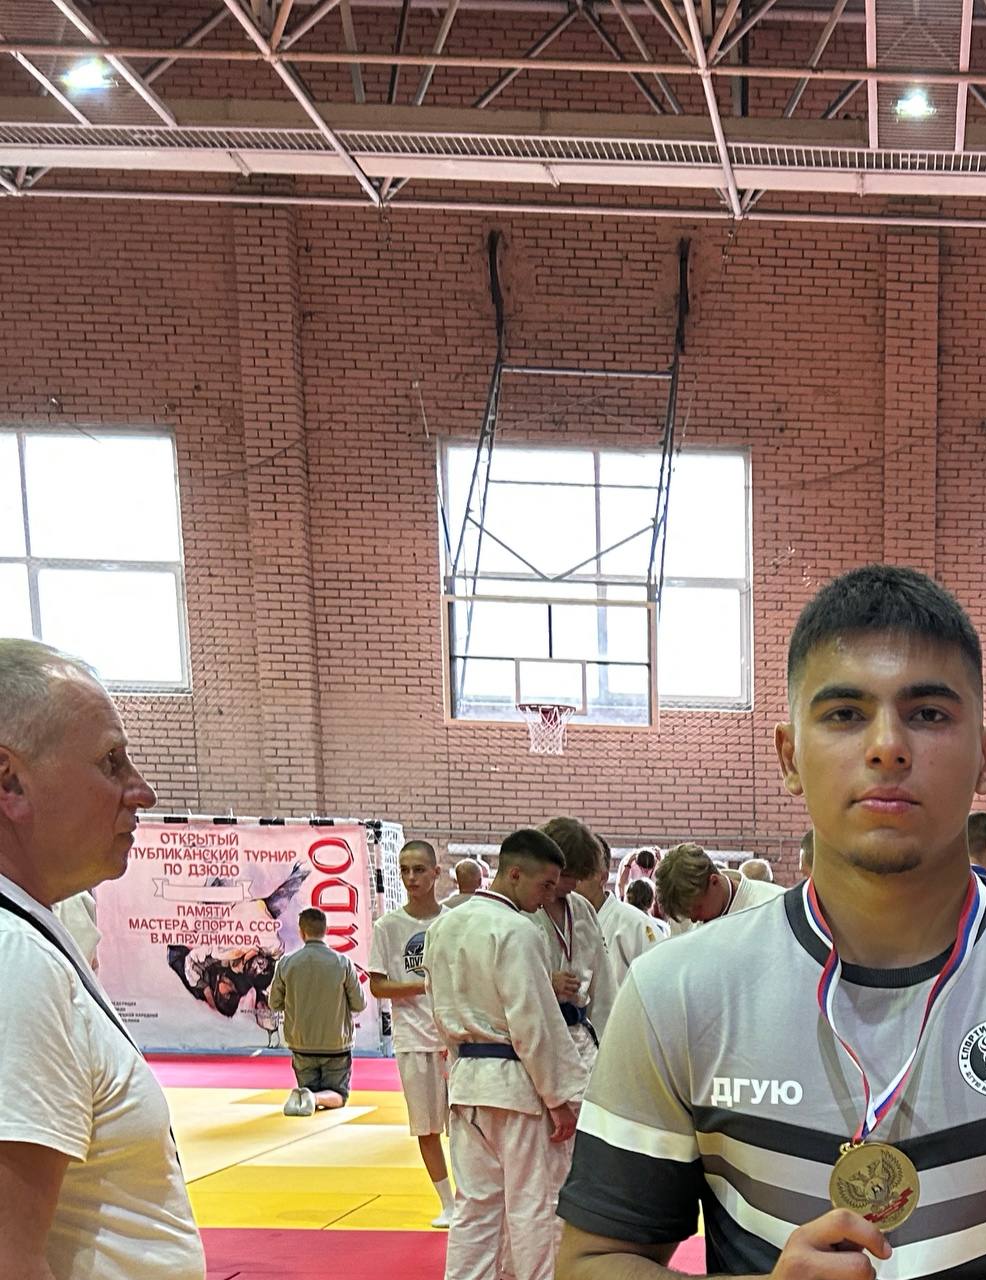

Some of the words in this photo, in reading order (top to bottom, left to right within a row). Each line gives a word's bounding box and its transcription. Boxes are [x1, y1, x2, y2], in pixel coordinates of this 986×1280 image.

[160, 832, 239, 846] ОТКРЫТЫЙ
[244, 850, 297, 862] ТУРНИР
[164, 863, 182, 876] ПО
[188, 864, 240, 877] ДЗЮДО
[177, 905, 230, 917] ПАМЯТИ
[129, 918, 189, 931] МАСТЕРА
[194, 920, 244, 931] СПОРТА
[249, 921, 281, 932] СССР
[711, 1077, 803, 1107] ДГУЮ
